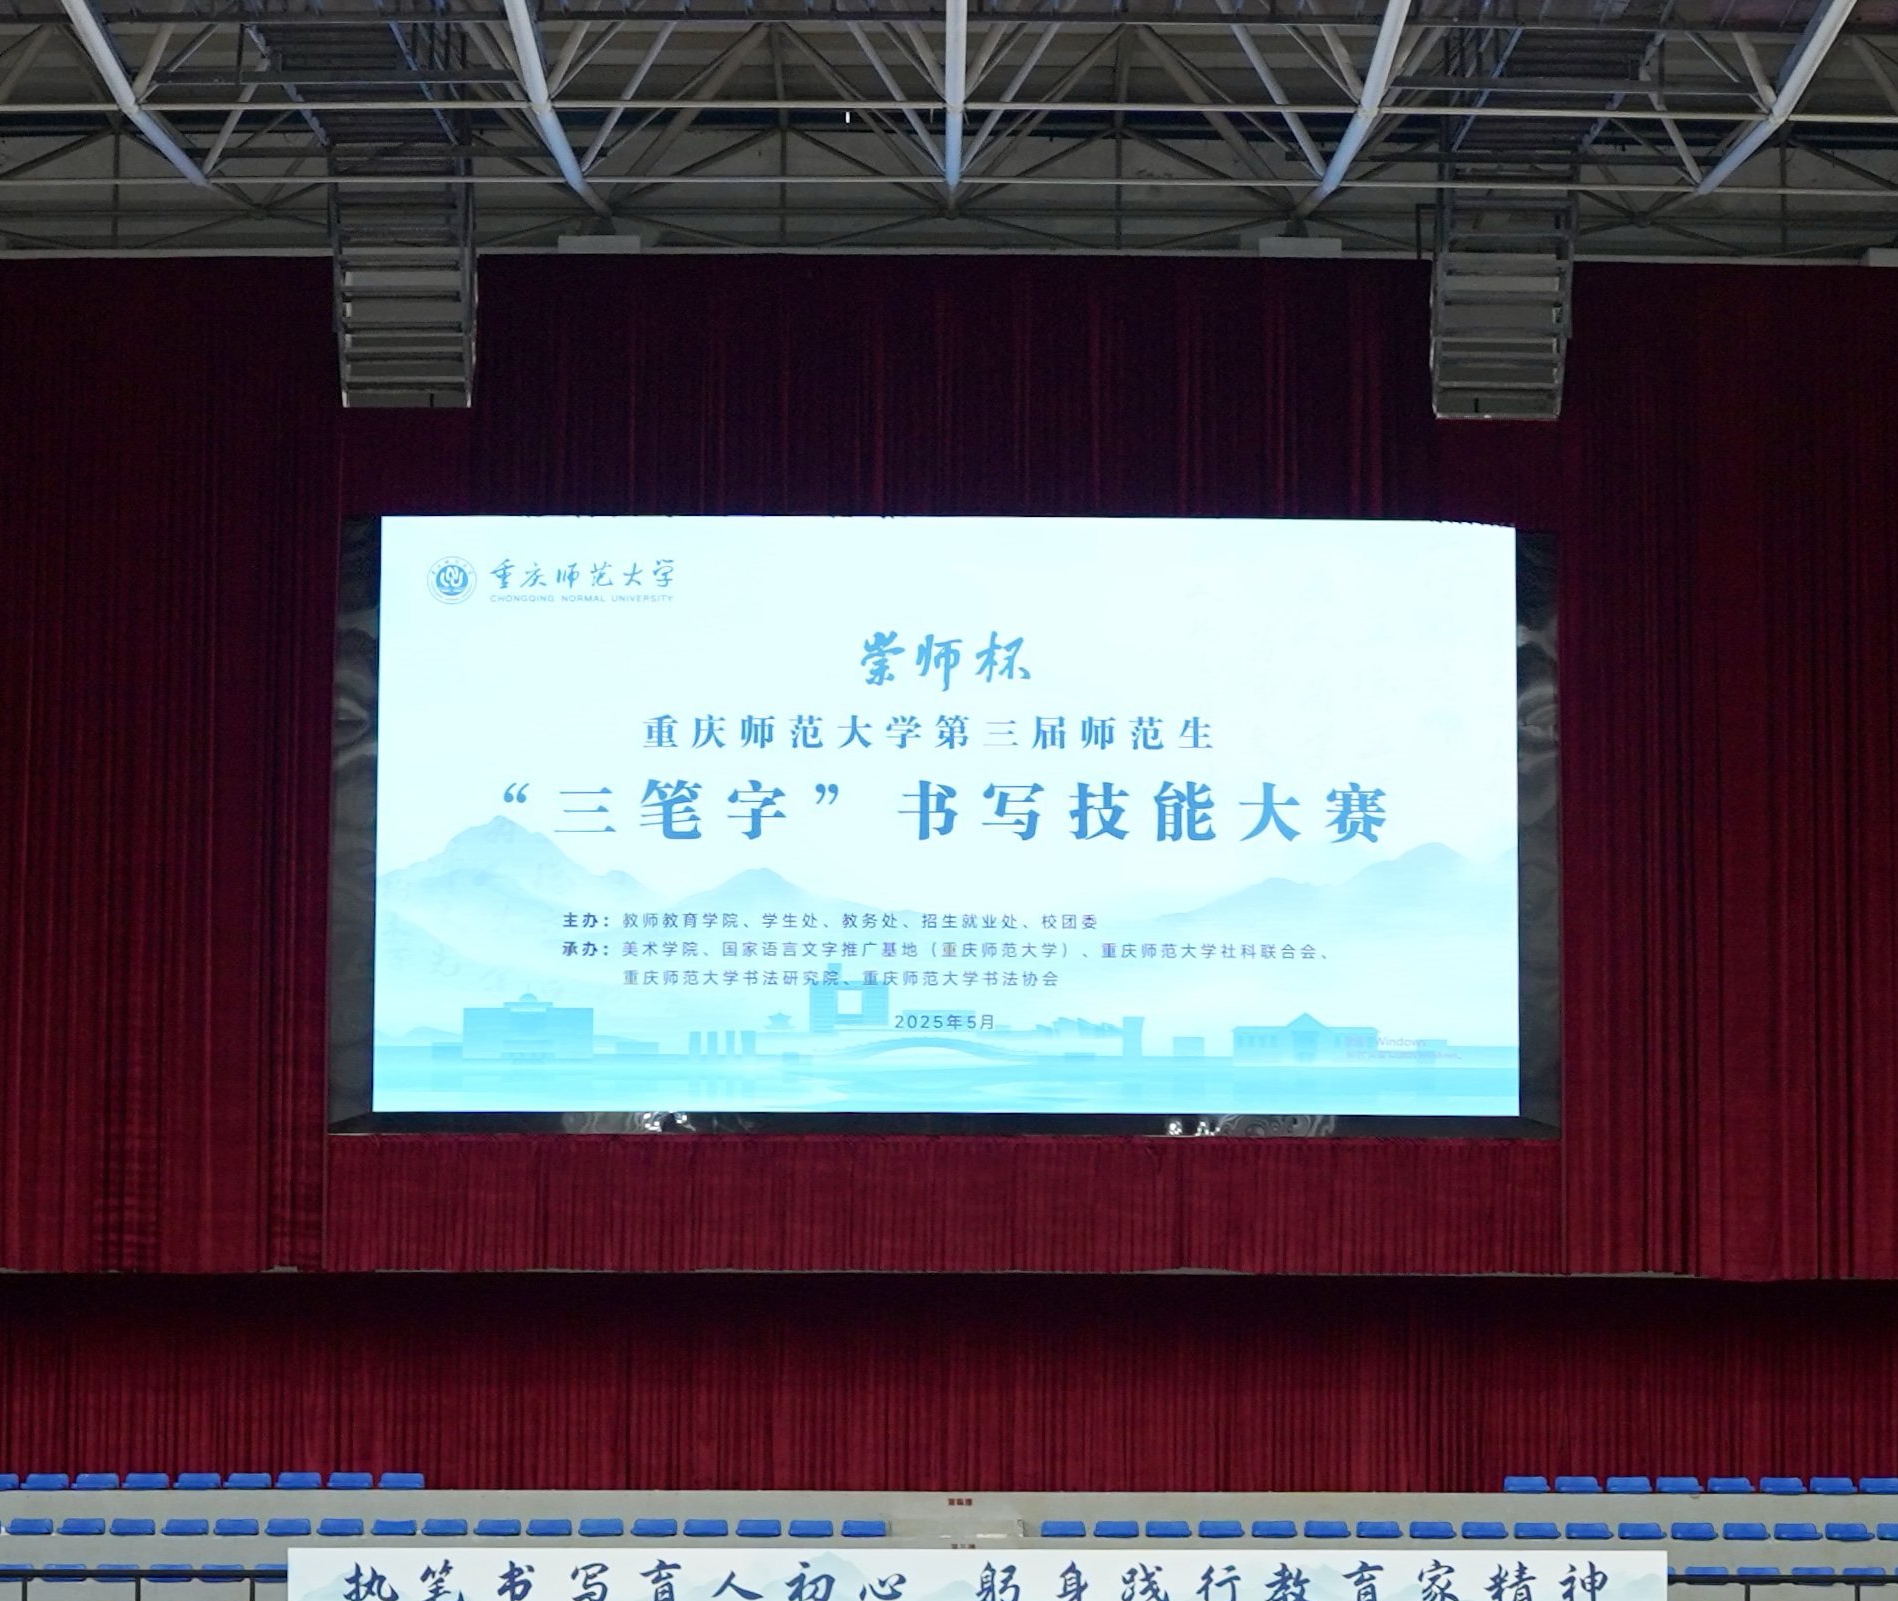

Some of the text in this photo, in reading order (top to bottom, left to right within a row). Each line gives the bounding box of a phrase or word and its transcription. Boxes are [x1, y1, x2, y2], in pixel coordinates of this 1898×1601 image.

[489, 557, 676, 590] 重庆师范大学
[489, 594, 675, 603] CHONGQING NORMAL UNIVERSITY
[641, 713, 1217, 752] 重庆师范大学第三届师范生
[897, 779, 1390, 845] 书写技能大赛
[622, 970, 1059, 988] 重庆师范大学书法研究院、重庆师范大学书法协会
[894, 1014, 995, 1031] 2025年5月
